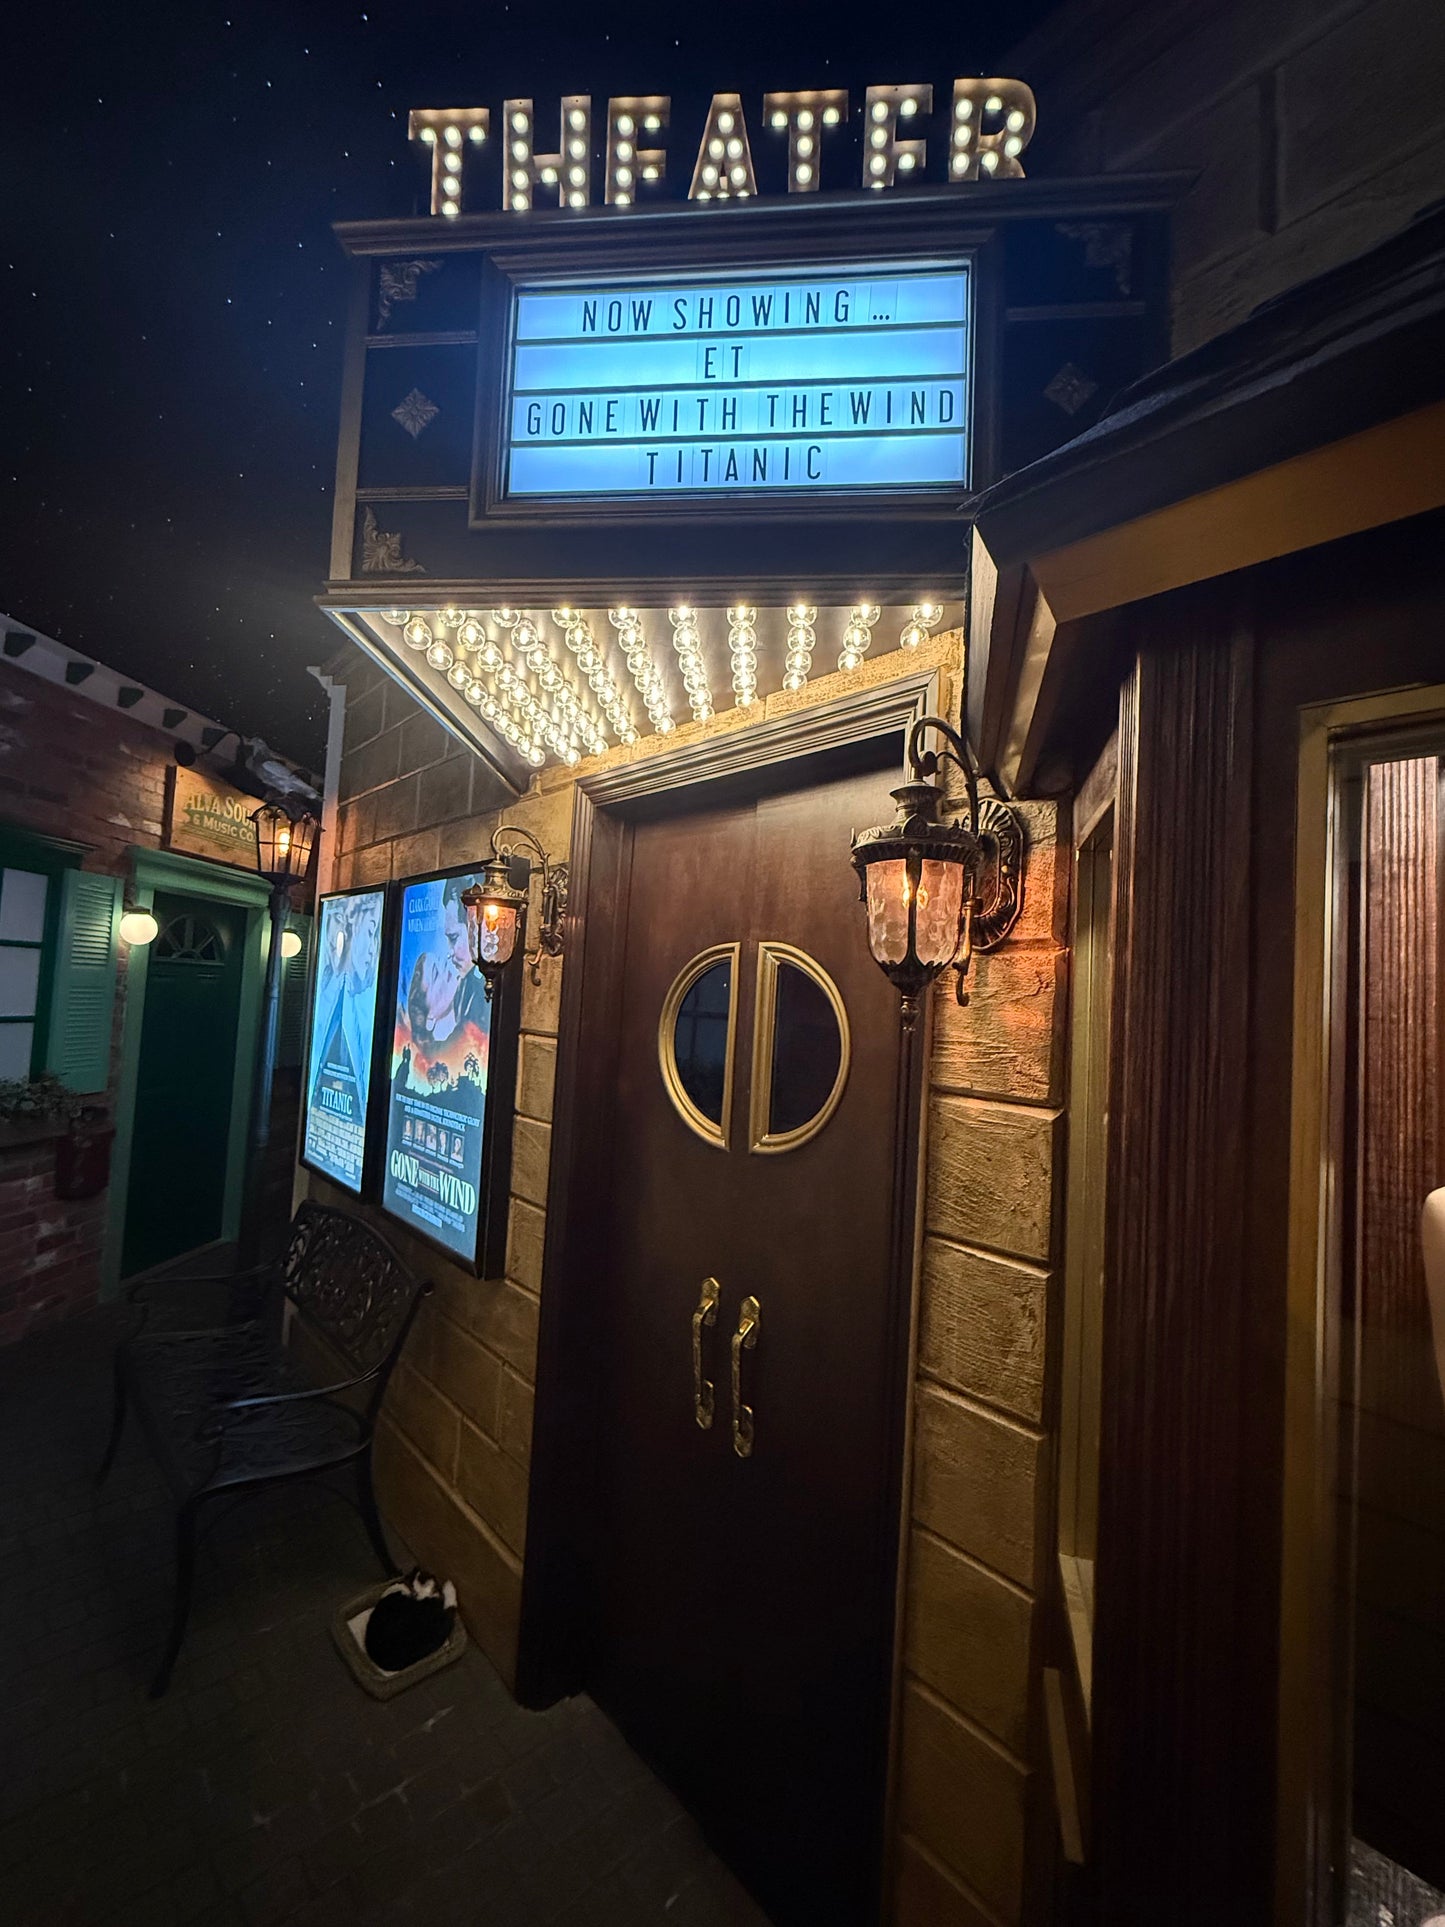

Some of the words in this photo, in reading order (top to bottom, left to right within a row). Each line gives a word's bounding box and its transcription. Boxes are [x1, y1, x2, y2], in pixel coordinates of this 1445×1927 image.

[408, 77, 1037, 216] THEATER
[582, 299, 653, 332] NOW
[672, 289, 850, 331] SHOWING
[704, 345, 744, 379] ET
[527, 399, 619, 436] GONE
[640, 397, 737, 432] WITH
[766, 392, 834, 428] THE
[849, 389, 955, 425] WIND
[646, 445, 822, 486] TITANIC
[203, 815, 238, 836] MUSIC
[321, 1085, 353, 1116] TITANIC
[390, 1148, 420, 1189] GONE
[438, 1170, 476, 1216] WIND
